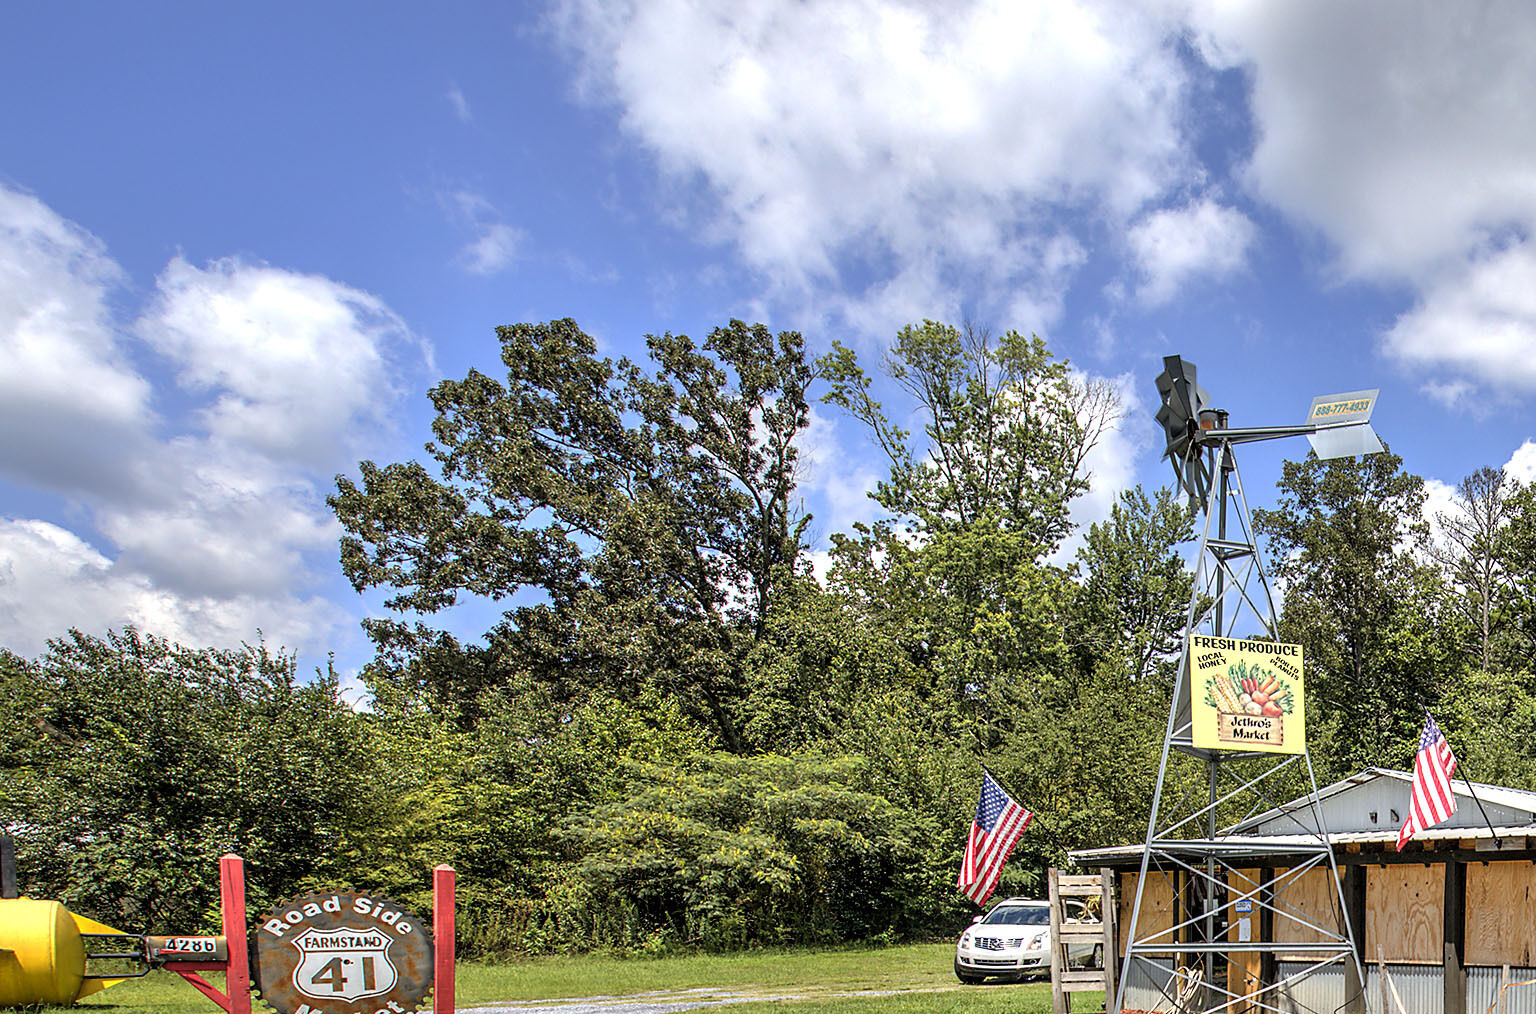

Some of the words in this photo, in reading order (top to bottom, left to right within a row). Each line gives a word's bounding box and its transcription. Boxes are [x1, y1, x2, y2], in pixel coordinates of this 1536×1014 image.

[1194, 636, 1236, 651] FRESH
[1239, 641, 1299, 657] PRODUCE
[1197, 651, 1223, 663] LOCAL
[1198, 658, 1227, 670] HONEY
[1269, 658, 1300, 681] PEANUTS
[1230, 716, 1272, 729] Jethro's
[1233, 728, 1270, 740] Market
[263, 896, 342, 937] Road
[353, 897, 413, 935] Side
[166, 938, 215, 952] 4286
[304, 936, 382, 949] FARMSTAND
[311, 956, 377, 993] 41
